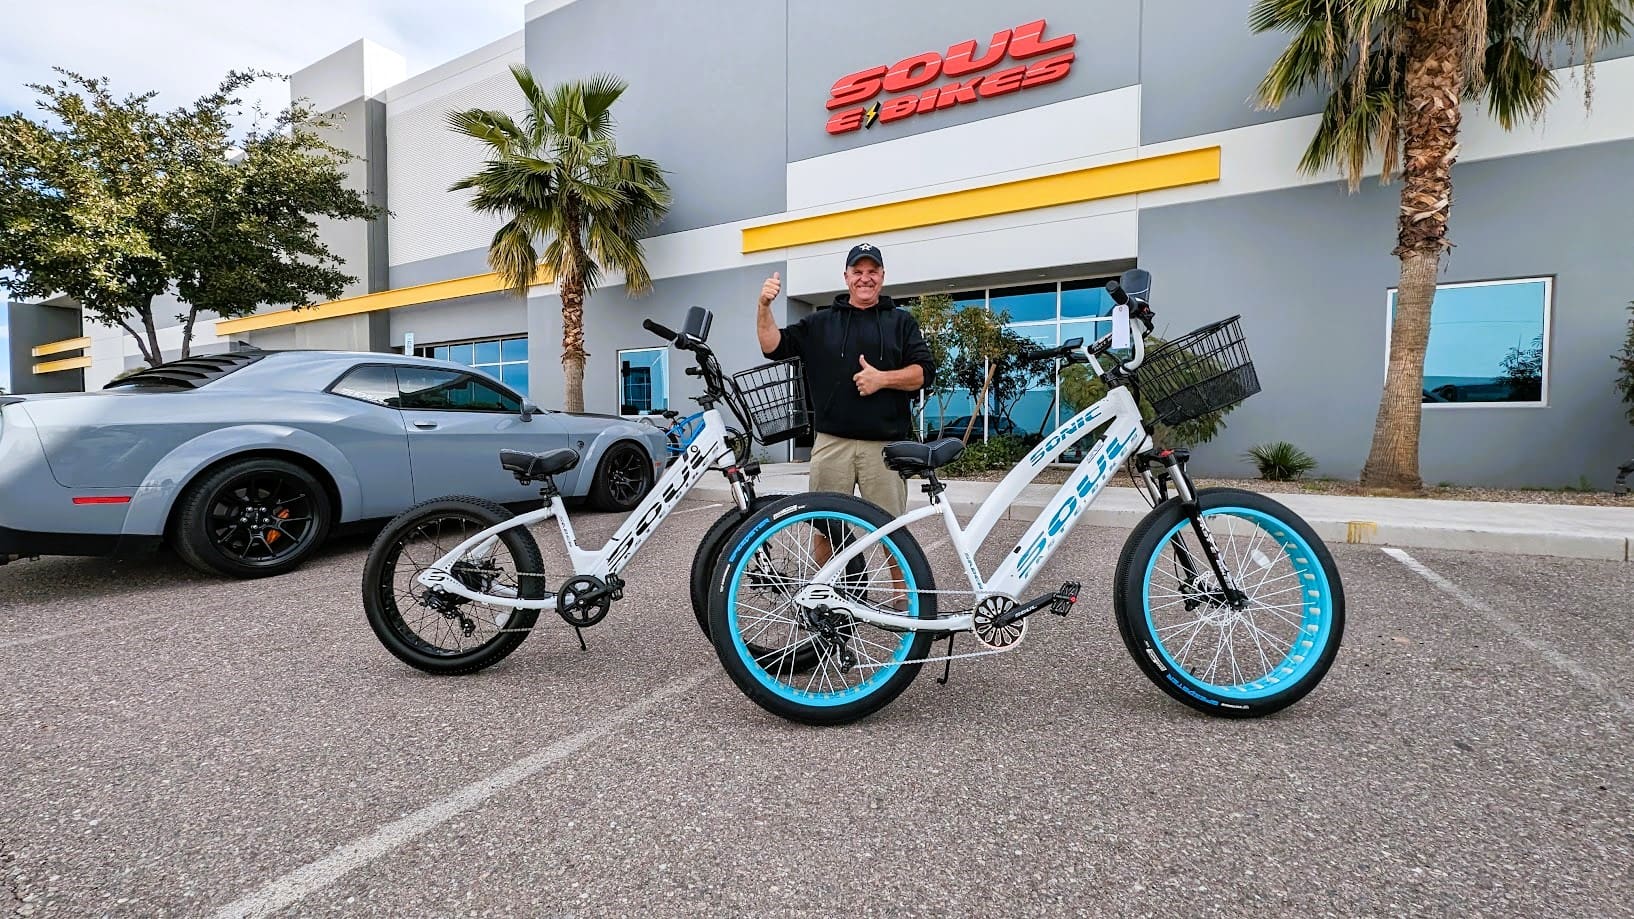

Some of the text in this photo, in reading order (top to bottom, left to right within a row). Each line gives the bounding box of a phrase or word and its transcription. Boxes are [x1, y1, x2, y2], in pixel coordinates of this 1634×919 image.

[825, 19, 1077, 111] SOUL
[1029, 406, 1103, 467] SONIC
[606, 441, 719, 573] SOUL
[1016, 427, 1138, 580] SOUL
